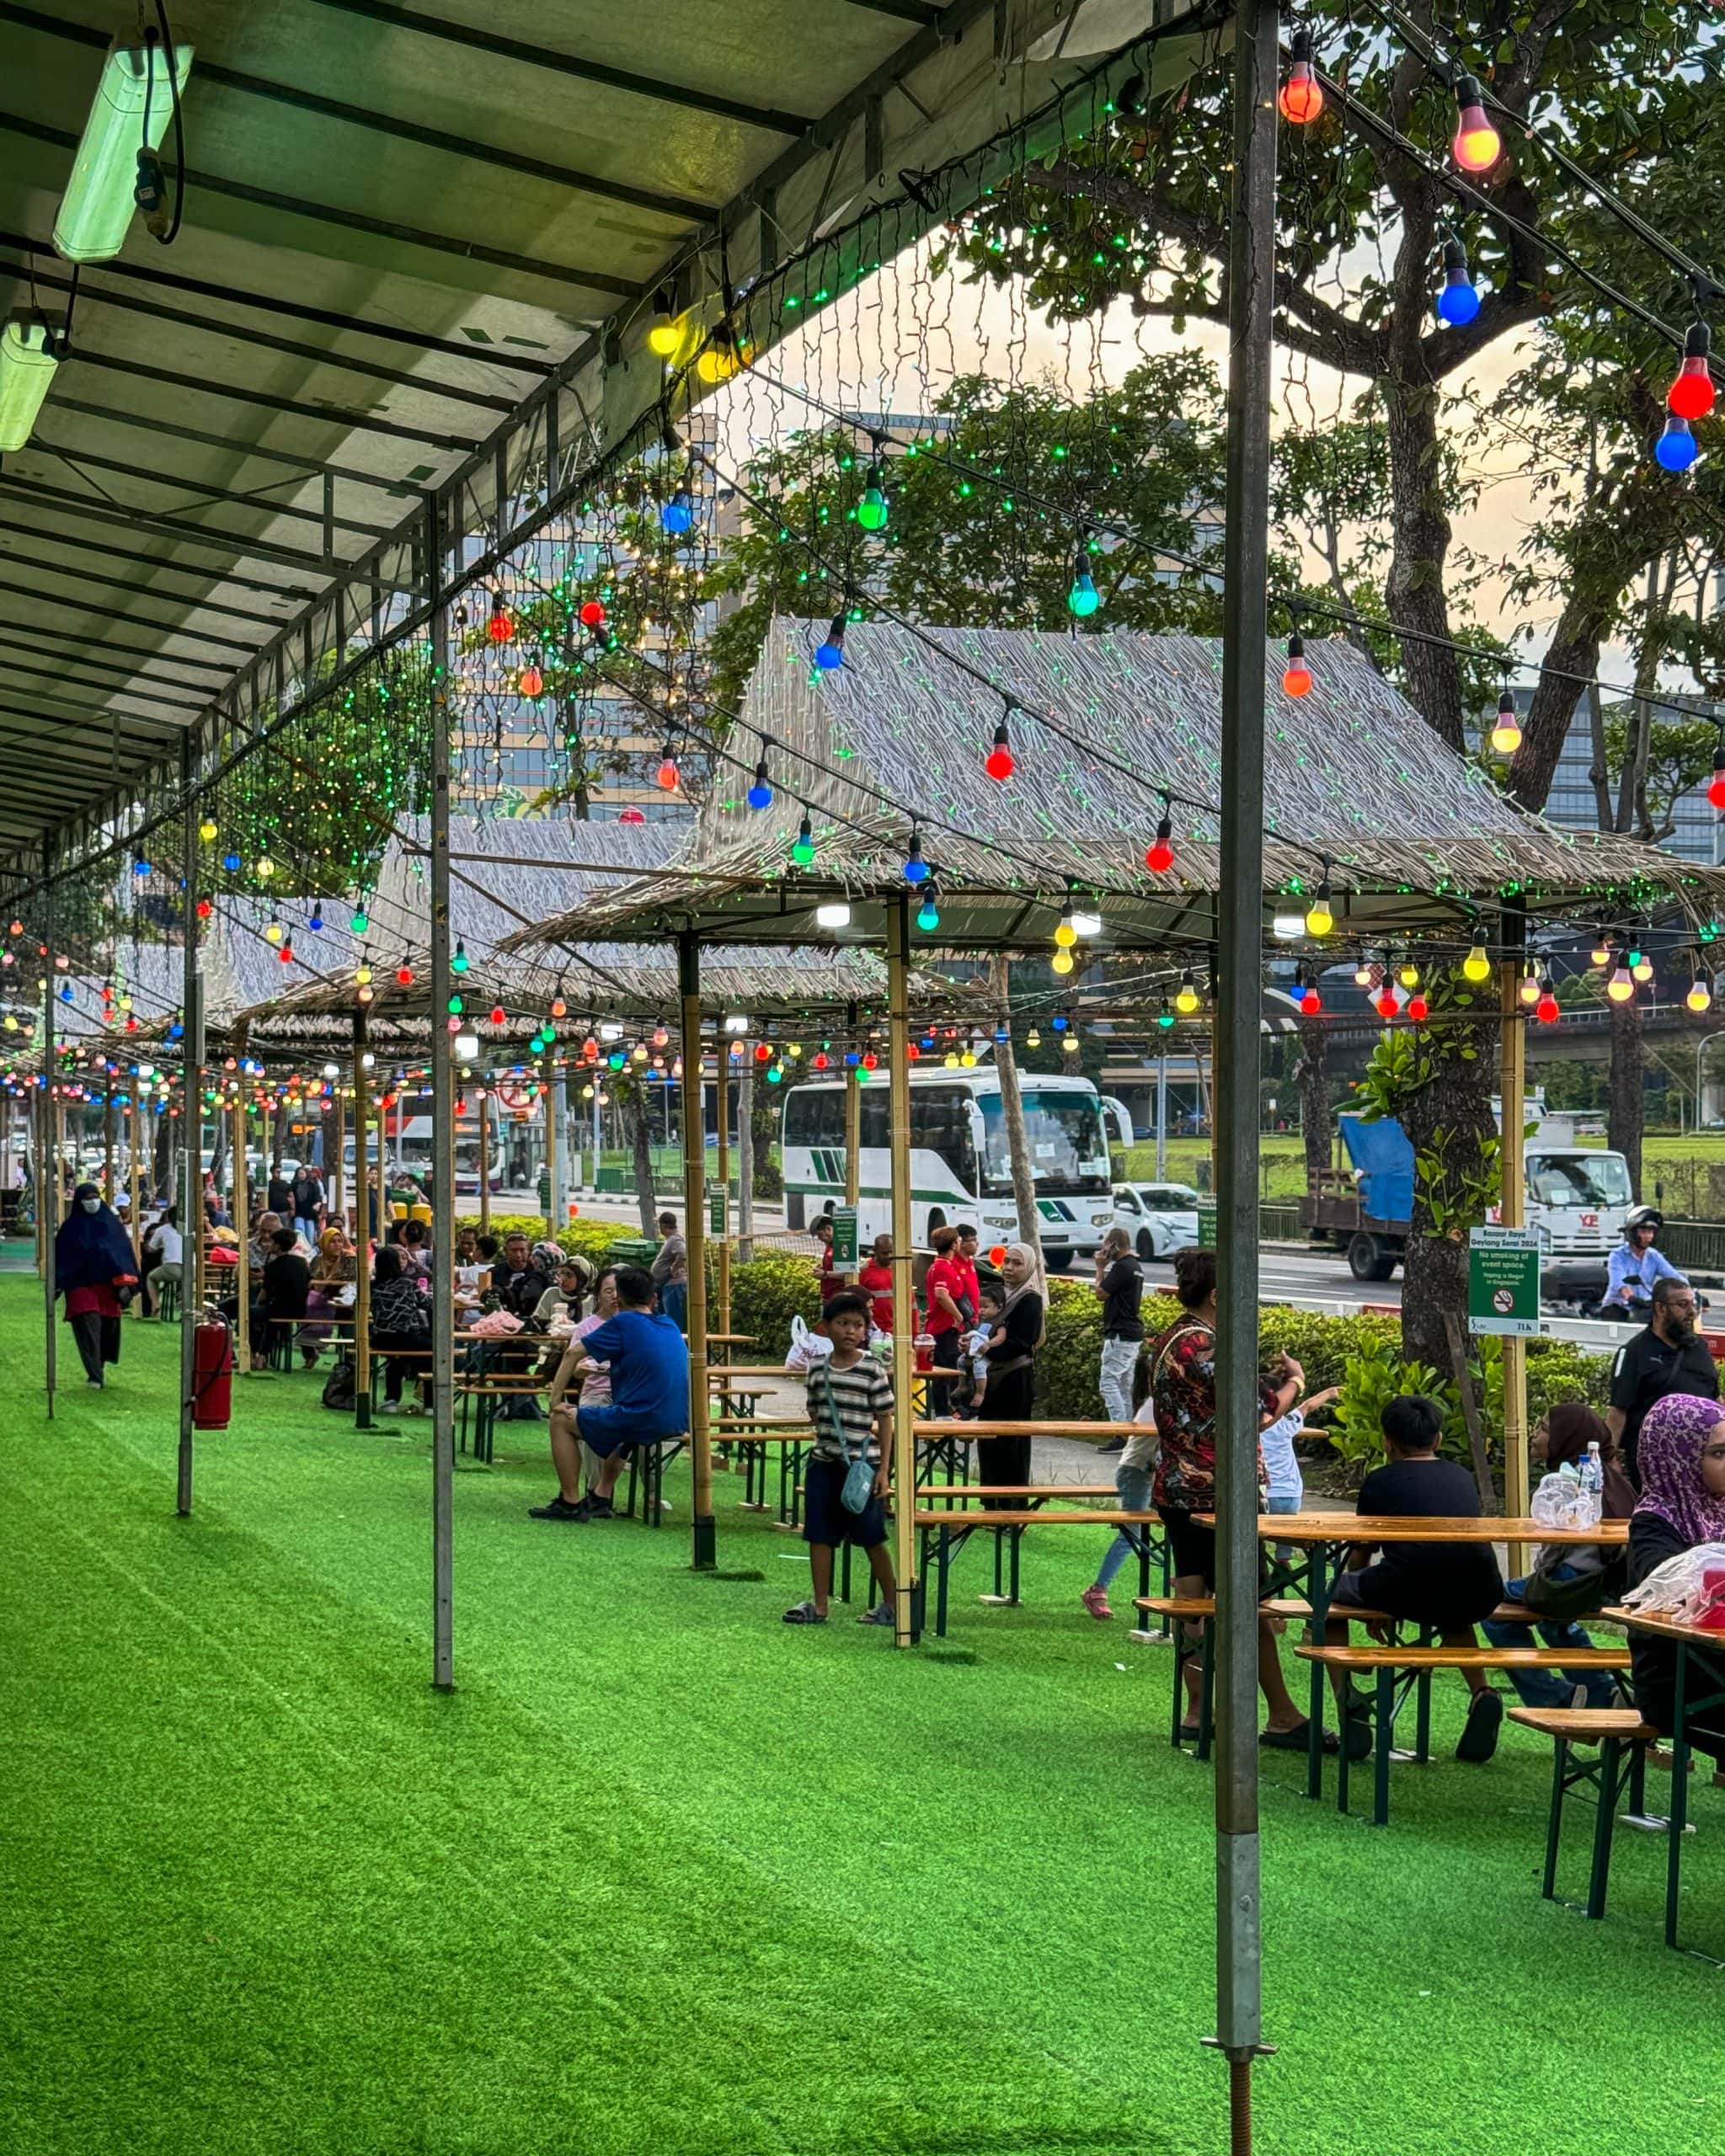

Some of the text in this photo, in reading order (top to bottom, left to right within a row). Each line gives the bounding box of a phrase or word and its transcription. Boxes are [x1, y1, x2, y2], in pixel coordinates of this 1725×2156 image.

[1509, 1230, 1526, 1239] Raya
[1471, 1239, 1500, 1247] Geylang
[1491, 1251, 1519, 1261] smoking
